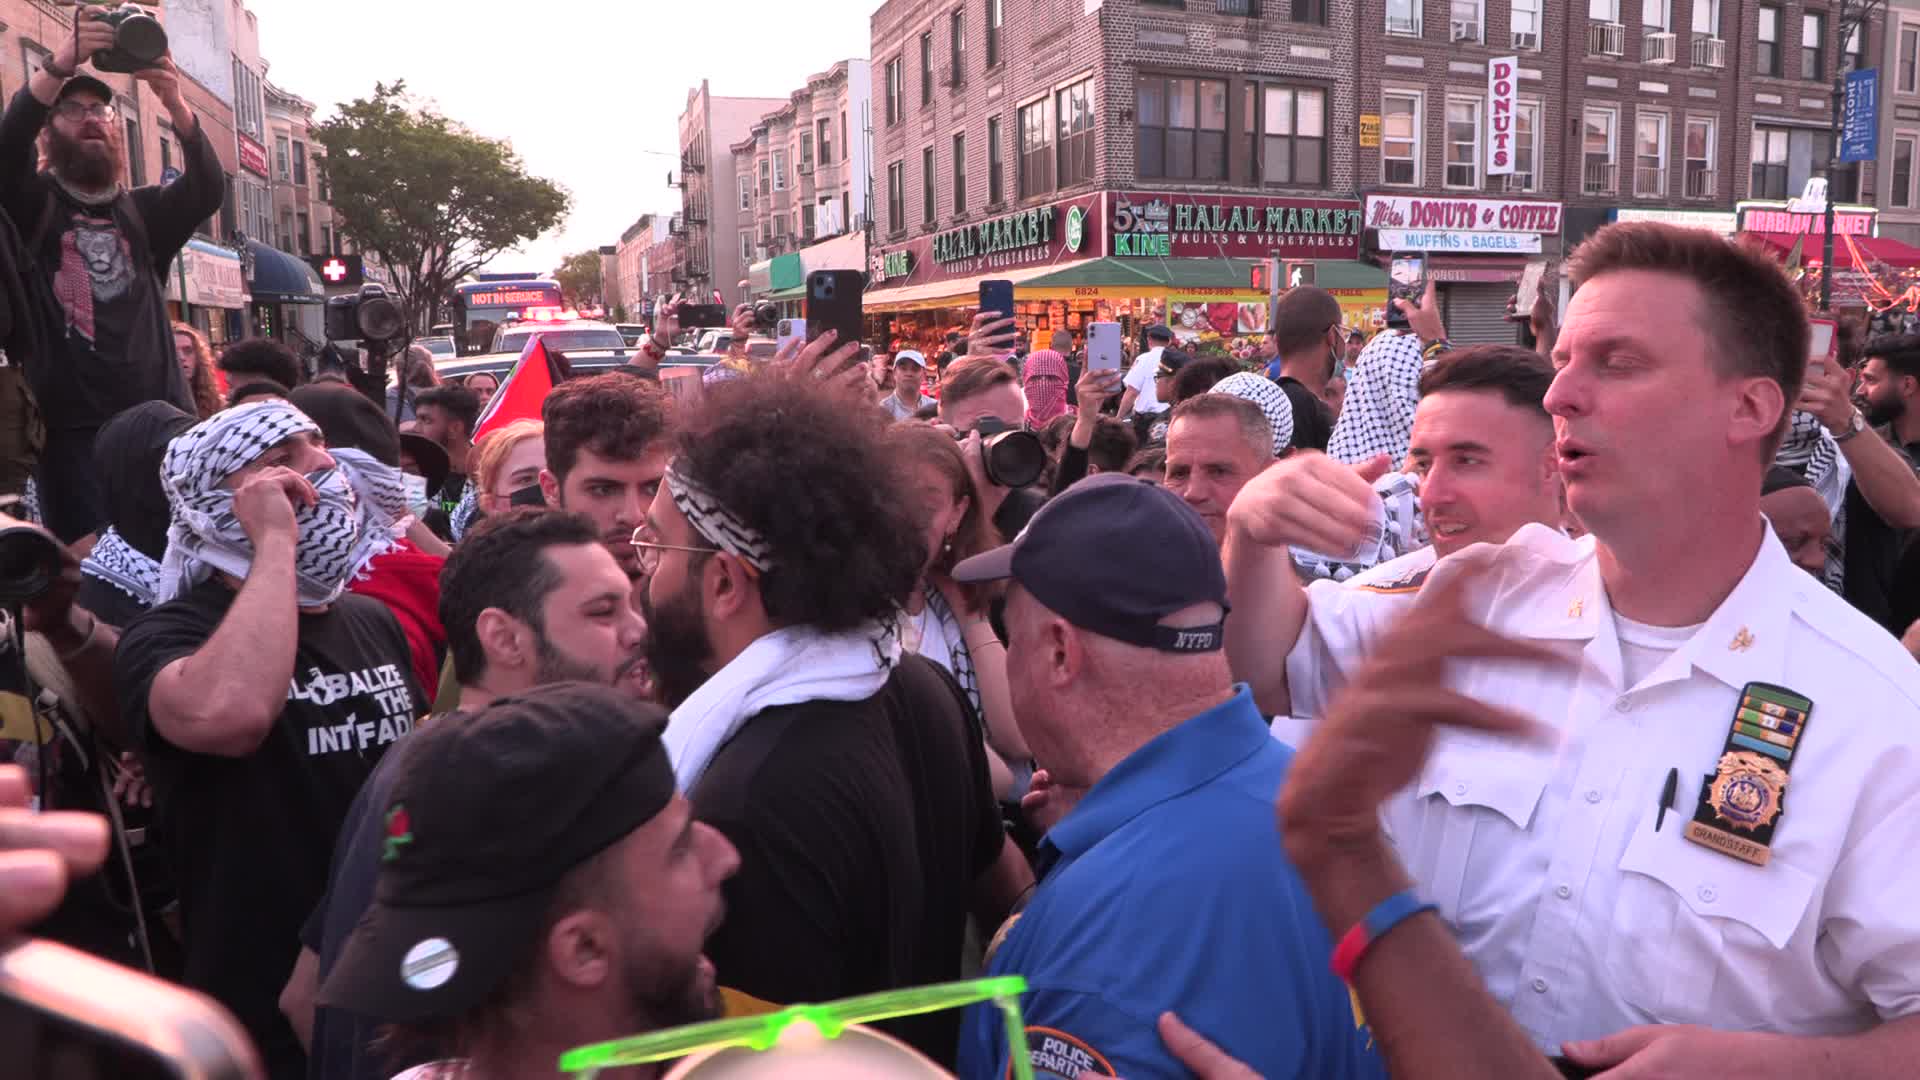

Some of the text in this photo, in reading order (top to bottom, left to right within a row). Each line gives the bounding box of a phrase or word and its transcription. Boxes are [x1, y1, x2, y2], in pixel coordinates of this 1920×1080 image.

[1493, 63, 1511, 167] DONUTS
[1844, 81, 1856, 141] WELCOME
[1174, 204, 1360, 234] HALAL MARKET
[1409, 201, 1477, 228] DONUTS
[1500, 205, 1557, 230] COFFEE
[1745, 210, 1812, 234] ARABIAN
[932, 226, 975, 264] HALAL
[979, 207, 1052, 254] MARKET
[1114, 233, 1169, 256] KING
[1171, 233, 1354, 247] FRUITS & VEGETABLES
[1405, 233, 1460, 248] MUFFINS
[1472, 236, 1518, 248] BAGELS
[988, 245, 1050, 267] VEGETABLES
[472, 290, 544, 304] NOT IN SERVICE
[1075, 287, 1099, 296] 6824
[1173, 631, 1213, 649] NYPD
[374, 686, 413, 716] THE
[1694, 827, 1761, 858] GRANDSTAFF
[1024, 1050, 1082, 1079] EPARTM
[1042, 1037, 1095, 1069] POLICE
